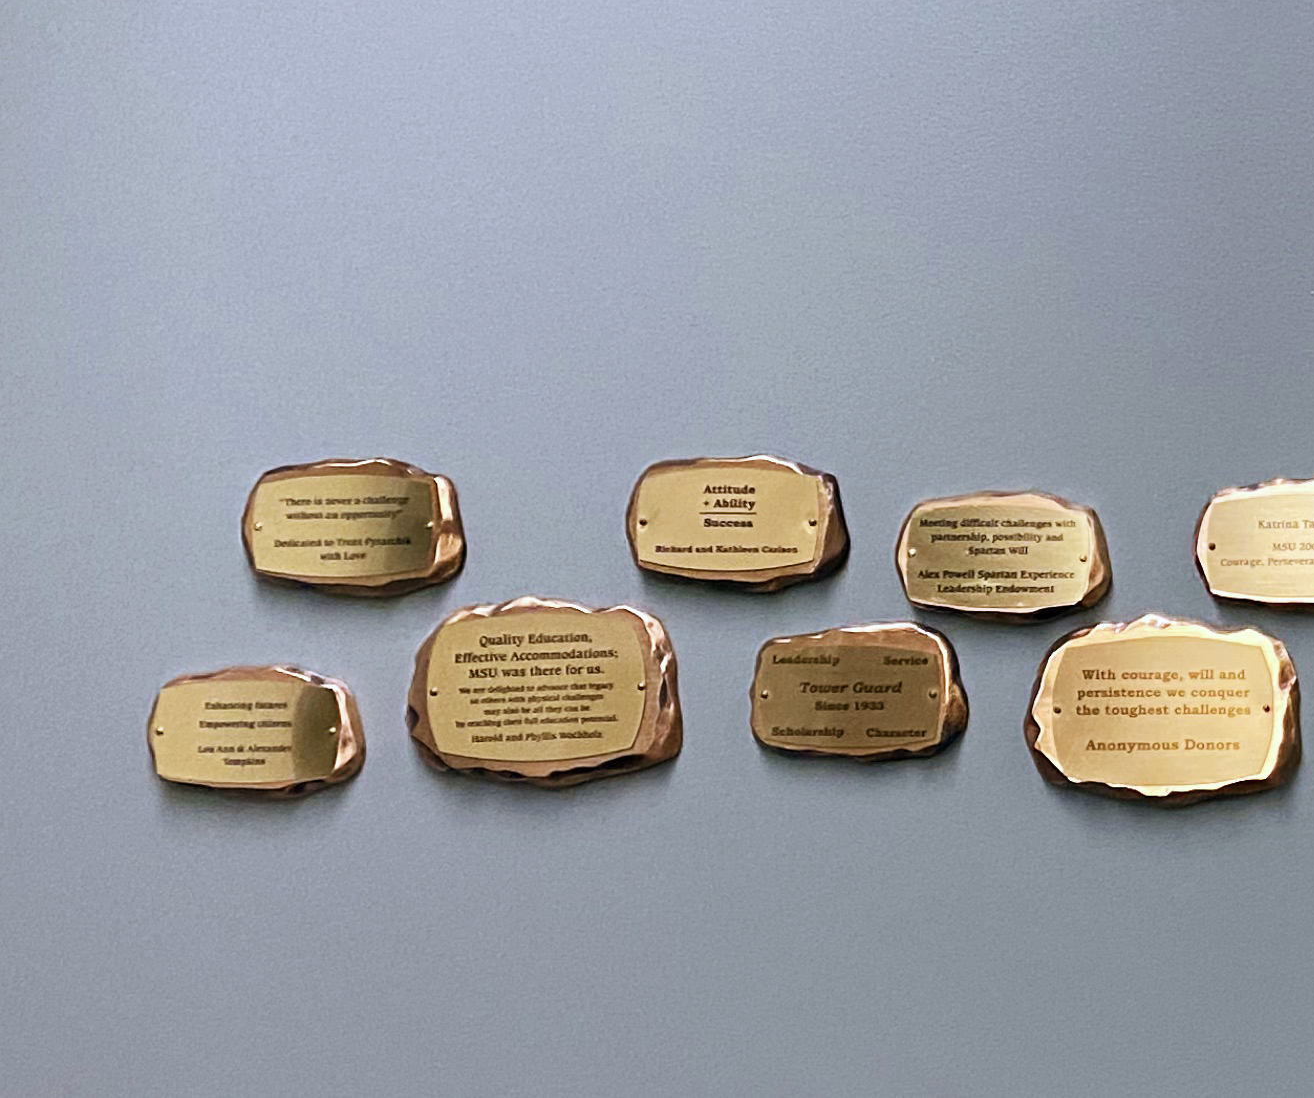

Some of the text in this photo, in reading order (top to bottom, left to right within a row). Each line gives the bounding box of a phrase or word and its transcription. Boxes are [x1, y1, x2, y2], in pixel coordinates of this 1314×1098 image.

[703, 484, 756, 495] Attitude
[713, 498, 756, 512] Ability
[703, 517, 754, 528] Success
[654, 545, 799, 554] Richard and Kathleen Carlson
[478, 632, 593, 649] Quality Education,
[454, 651, 508, 664] Effective
[771, 653, 841, 667] Leadership
[882, 651, 929, 666] Service
[468, 667, 499, 679] MSU
[500, 668, 527, 678] was
[529, 665, 562, 677] there
[565, 663, 585, 676] for
[1081, 668, 1245, 683] With courage, will and
[799, 680, 903, 694] Tower Guard
[1076, 687, 1250, 702] persistence we conquer
[814, 699, 851, 712] Since
[1075, 703, 1251, 719] the toughest challenges
[770, 726, 845, 739] Scholarship
[865, 727, 928, 739] Character
[1085, 738, 1240, 754] Anonymous Donors
